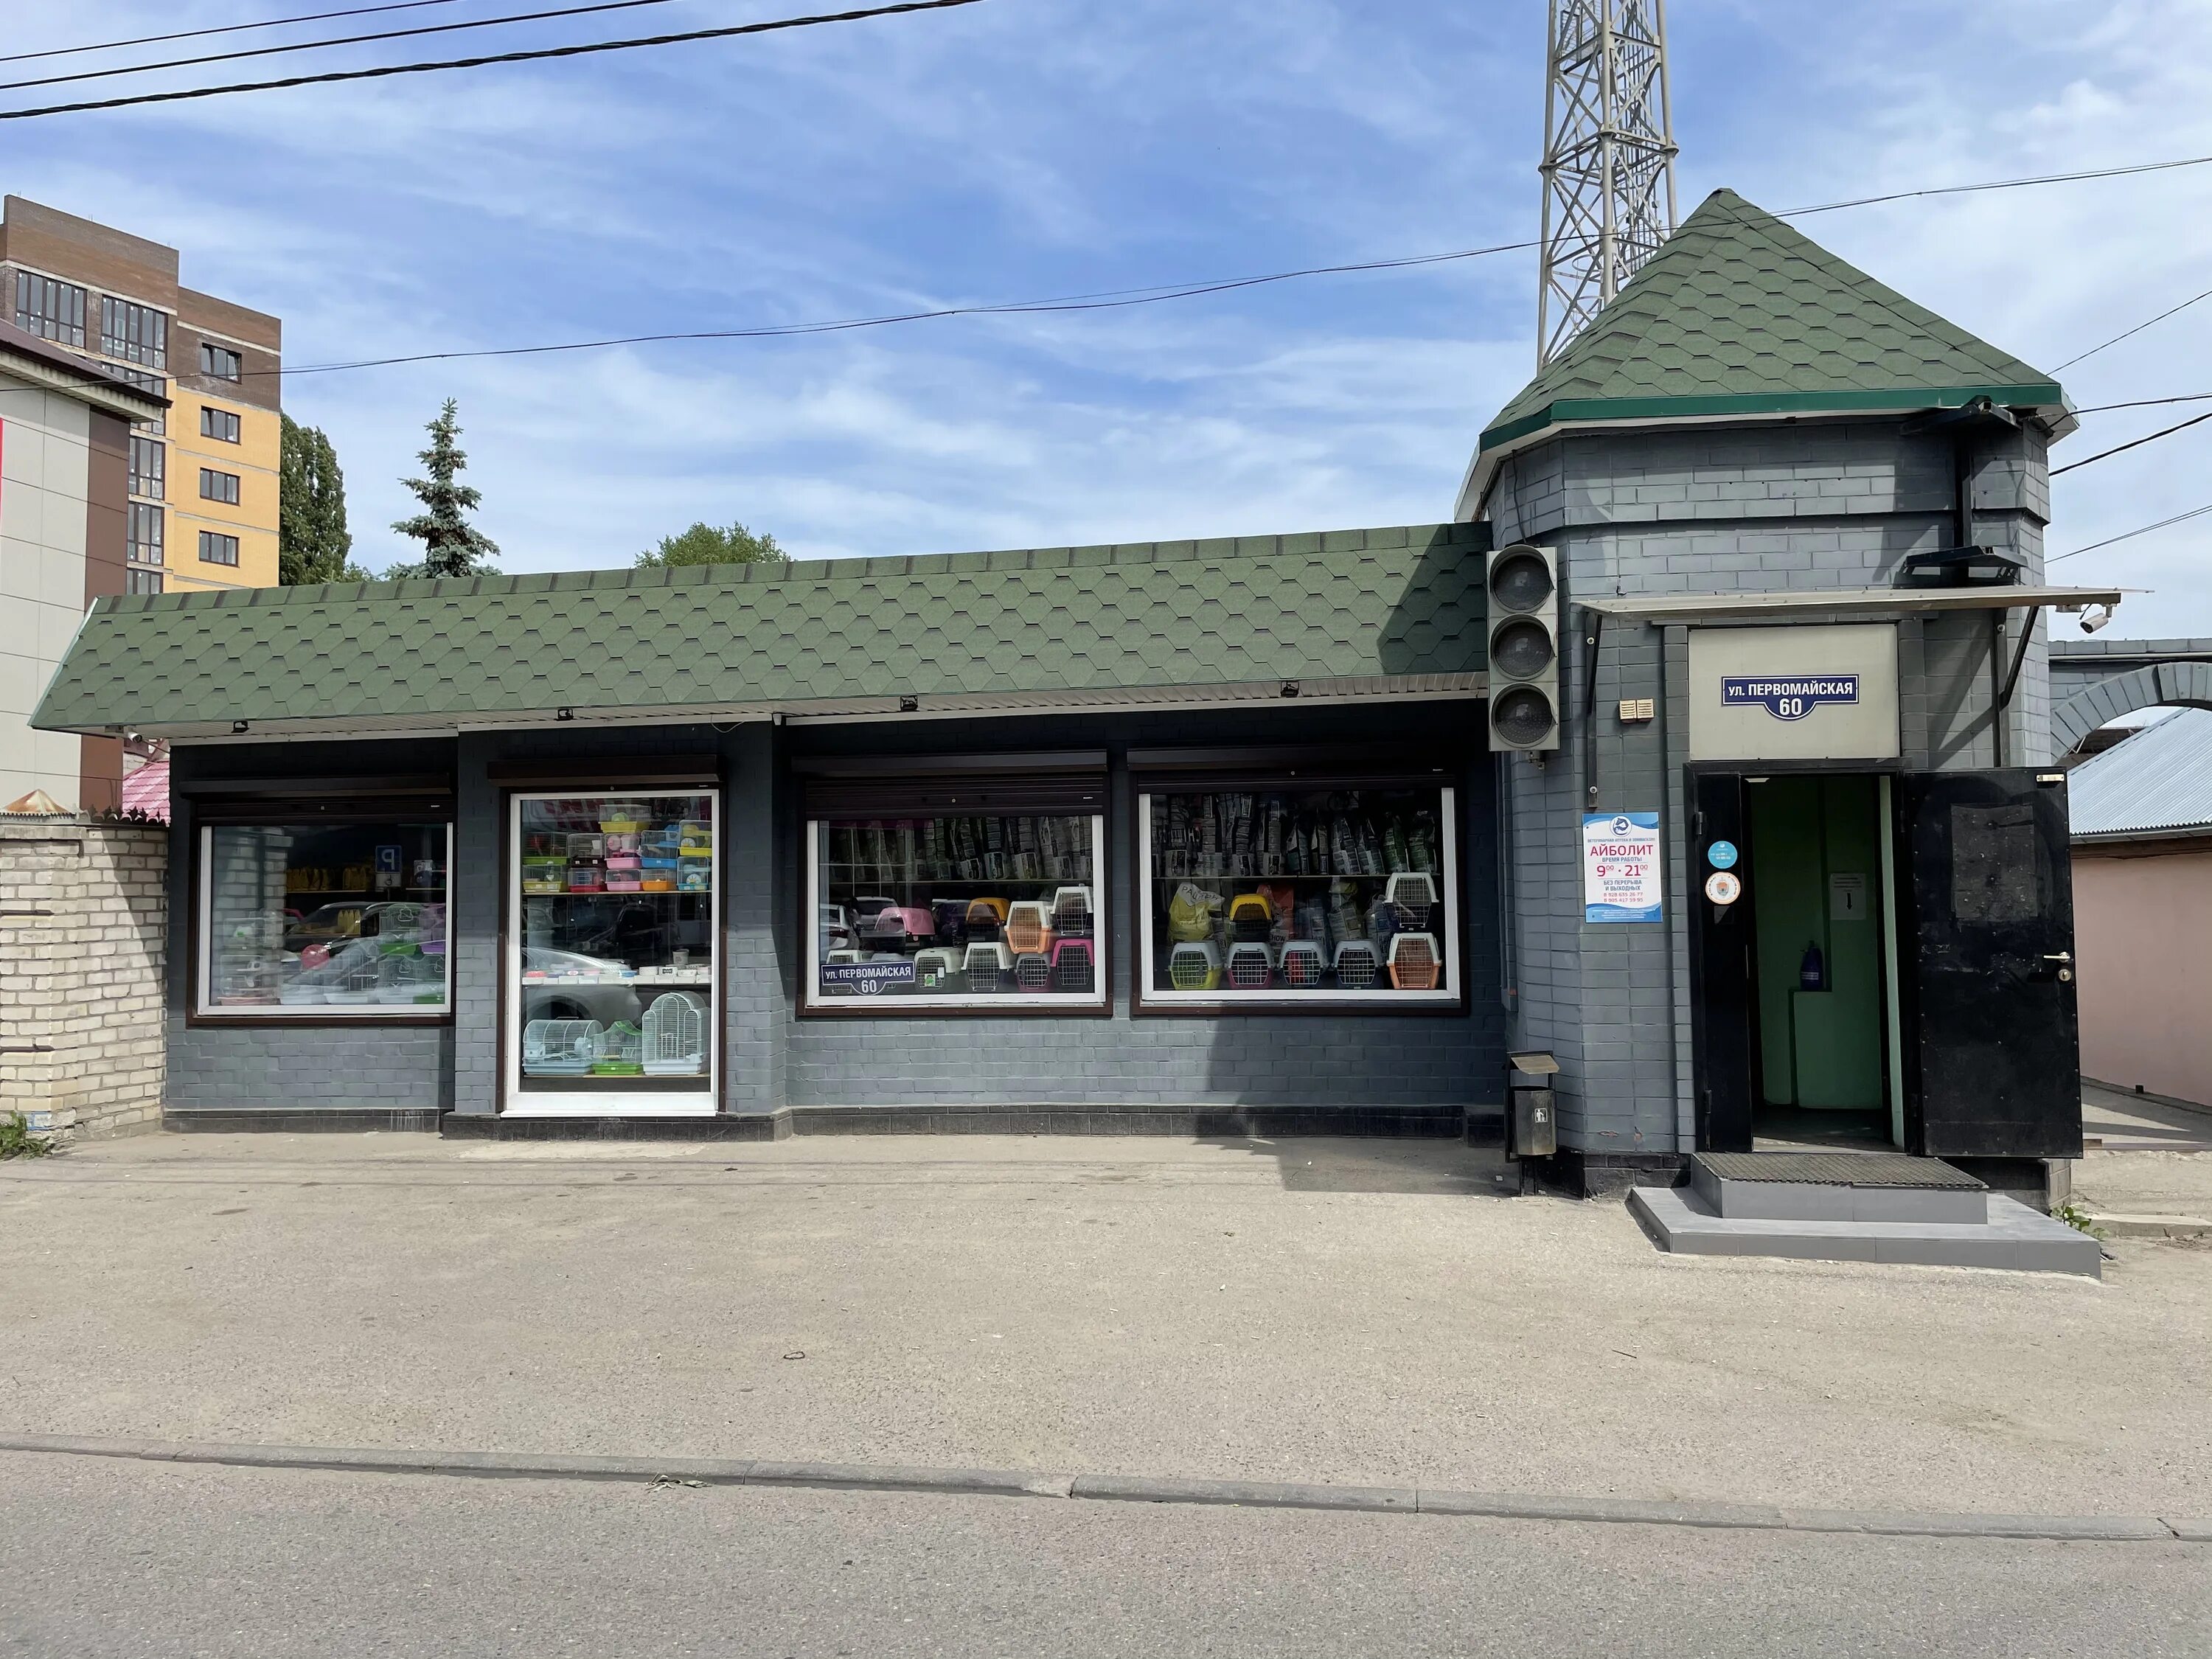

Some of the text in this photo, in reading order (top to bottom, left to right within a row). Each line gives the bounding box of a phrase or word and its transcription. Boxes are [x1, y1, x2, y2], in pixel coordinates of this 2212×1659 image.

[1728, 680, 1853, 696] ул. ПЕРВОМАЙСКАЯ
[1778, 698, 1803, 716] 60
[1590, 844, 1653, 856] АЙБОЛИТ
[825, 966, 911, 979] ул. ПЕРВОМАЙСКАЯ
[860, 979, 877, 993] 60
